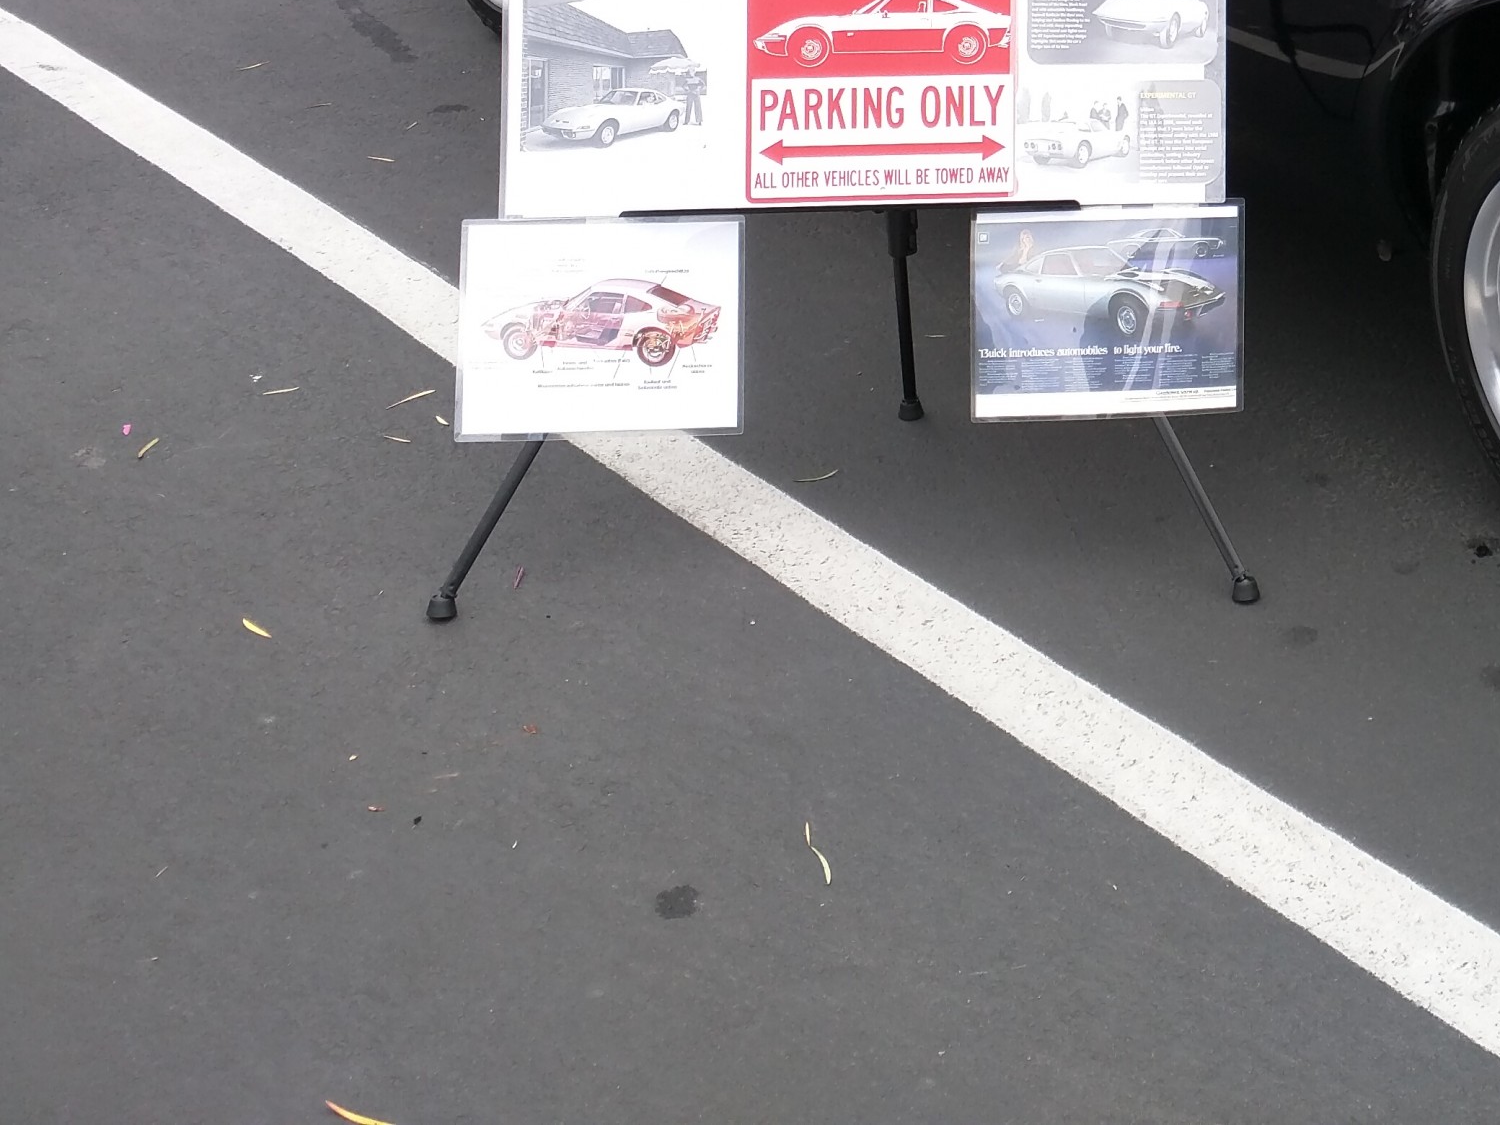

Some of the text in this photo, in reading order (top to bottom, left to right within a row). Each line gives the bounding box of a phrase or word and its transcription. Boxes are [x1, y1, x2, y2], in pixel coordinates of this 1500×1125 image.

[1187, 91, 1197, 99] GT
[760, 84, 1005, 131] PARKING ONLY
[754, 166, 1010, 189] ALL OTHER VEHICLES WILL BE TOWED AWAY
[978, 343, 1183, 359] Buick introduces automobiles to light your fire.
